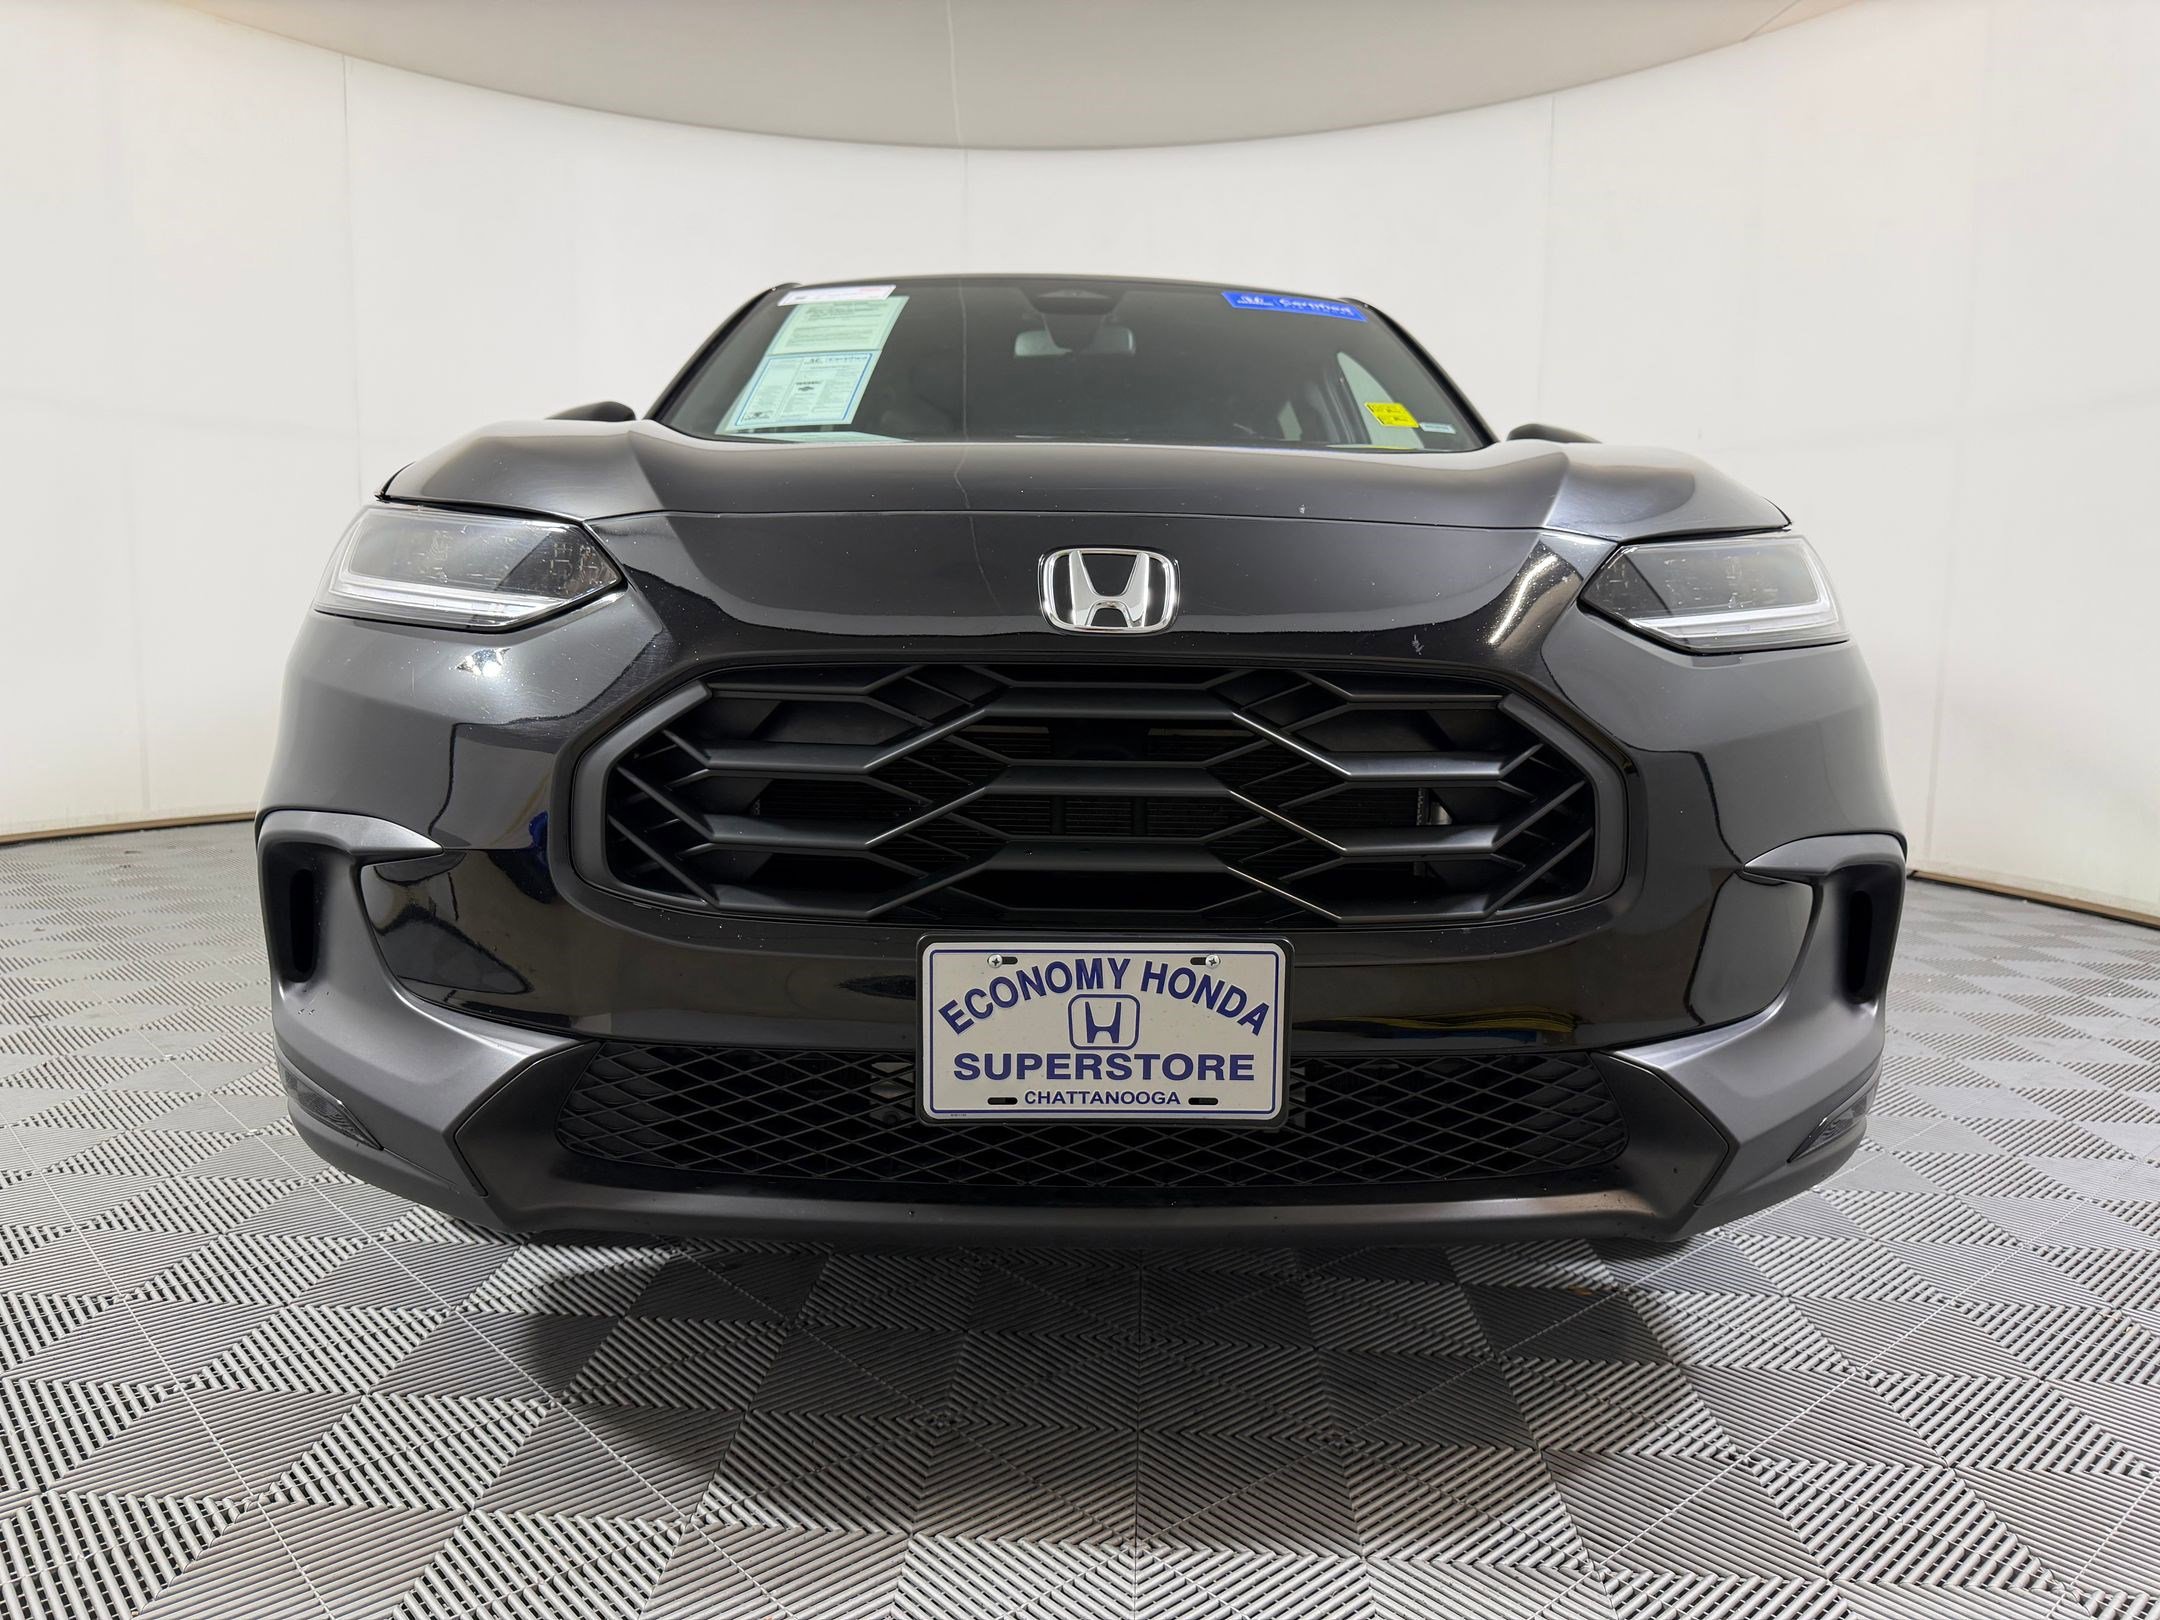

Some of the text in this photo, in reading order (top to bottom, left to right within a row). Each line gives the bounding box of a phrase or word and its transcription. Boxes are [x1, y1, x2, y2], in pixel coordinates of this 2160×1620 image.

[938, 957, 1270, 1036] ECONOMY HONDA
[953, 1052, 1255, 1082] SUPERSTORE
[1024, 1090, 1182, 1105] CHATTANOOGA
